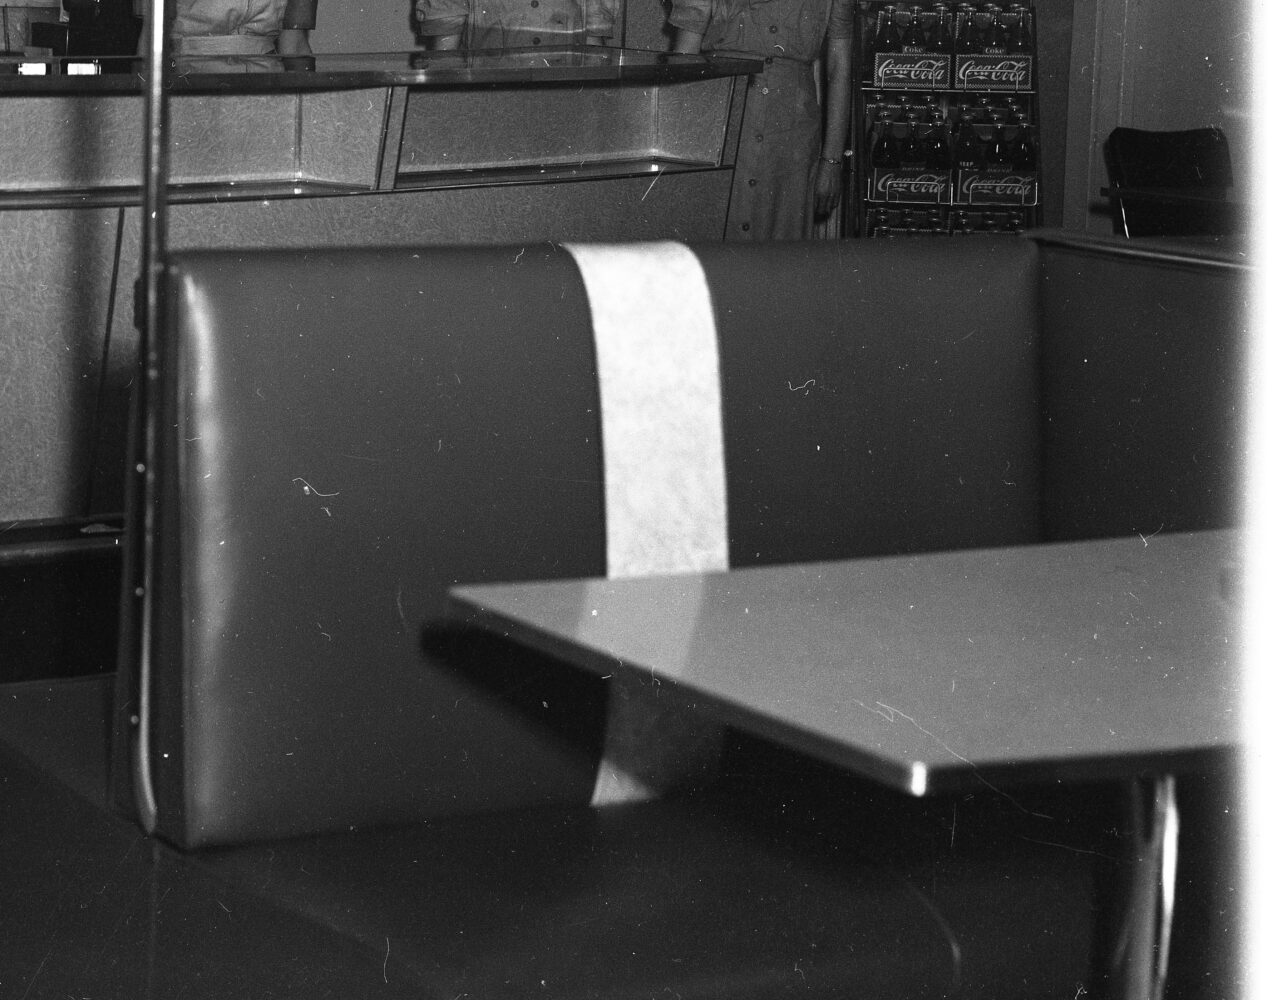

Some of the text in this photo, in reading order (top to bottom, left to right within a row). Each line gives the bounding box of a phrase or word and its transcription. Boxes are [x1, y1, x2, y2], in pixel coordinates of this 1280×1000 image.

[904, 46, 924, 54] Coke
[985, 47, 1005, 55] Coke
[878, 58, 947, 80] Coca-Cola
[959, 60, 1028, 82] Coca-Cola
[877, 173, 949, 193] Coca-Cola
[962, 175, 1035, 196] Coca-Cola
